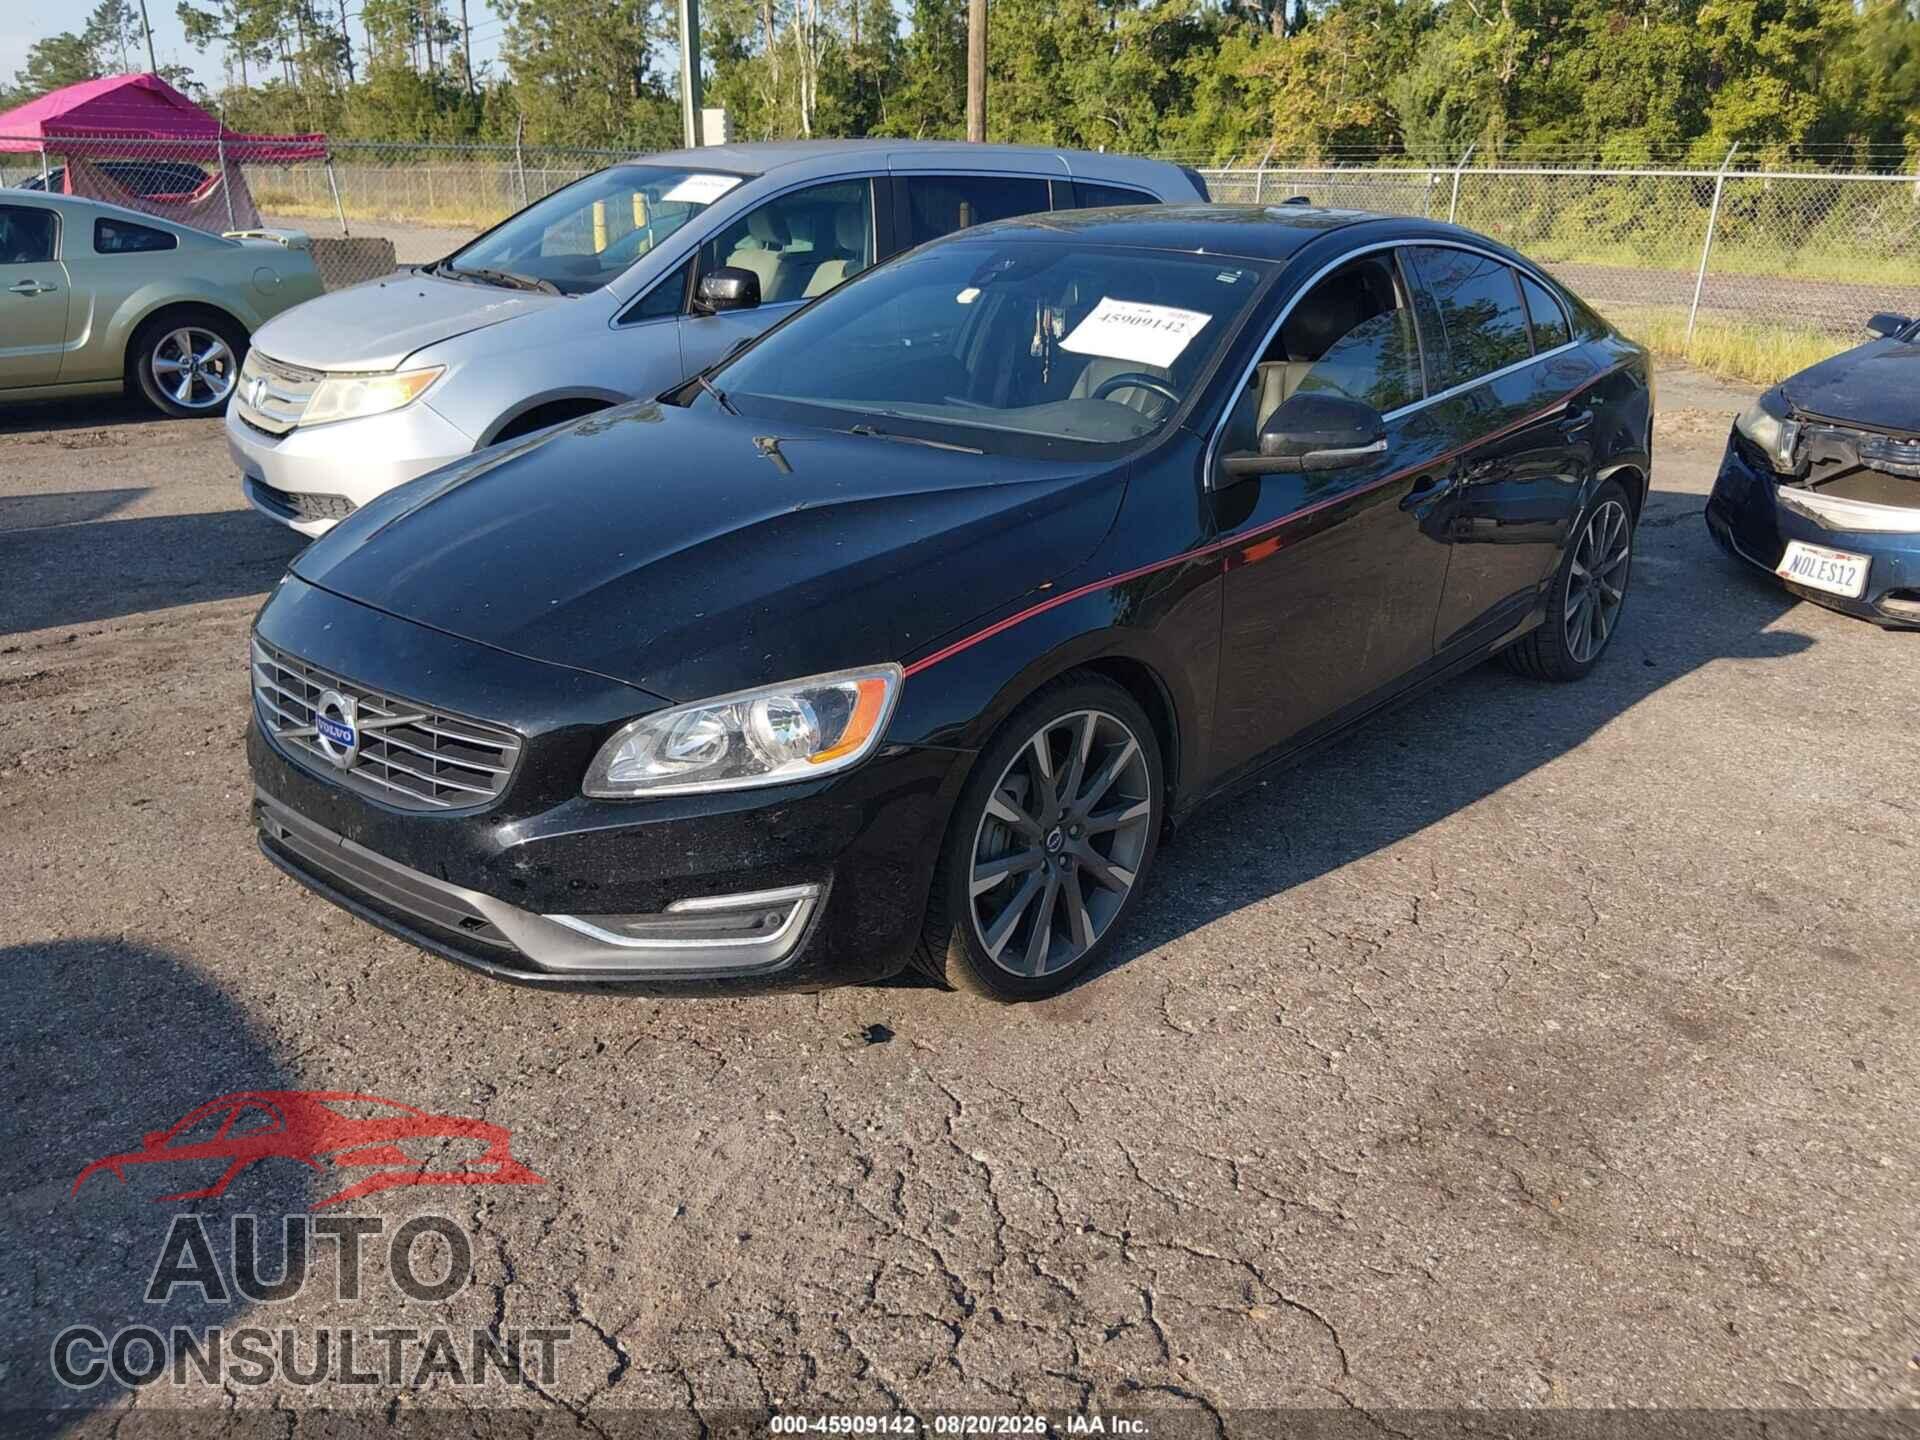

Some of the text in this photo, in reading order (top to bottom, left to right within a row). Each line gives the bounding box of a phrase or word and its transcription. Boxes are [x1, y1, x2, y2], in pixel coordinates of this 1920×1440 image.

[1098, 312, 1185, 333] 45909142
[1789, 554, 1856, 586] NOLES12
[318, 717, 352, 742] VOLVO
